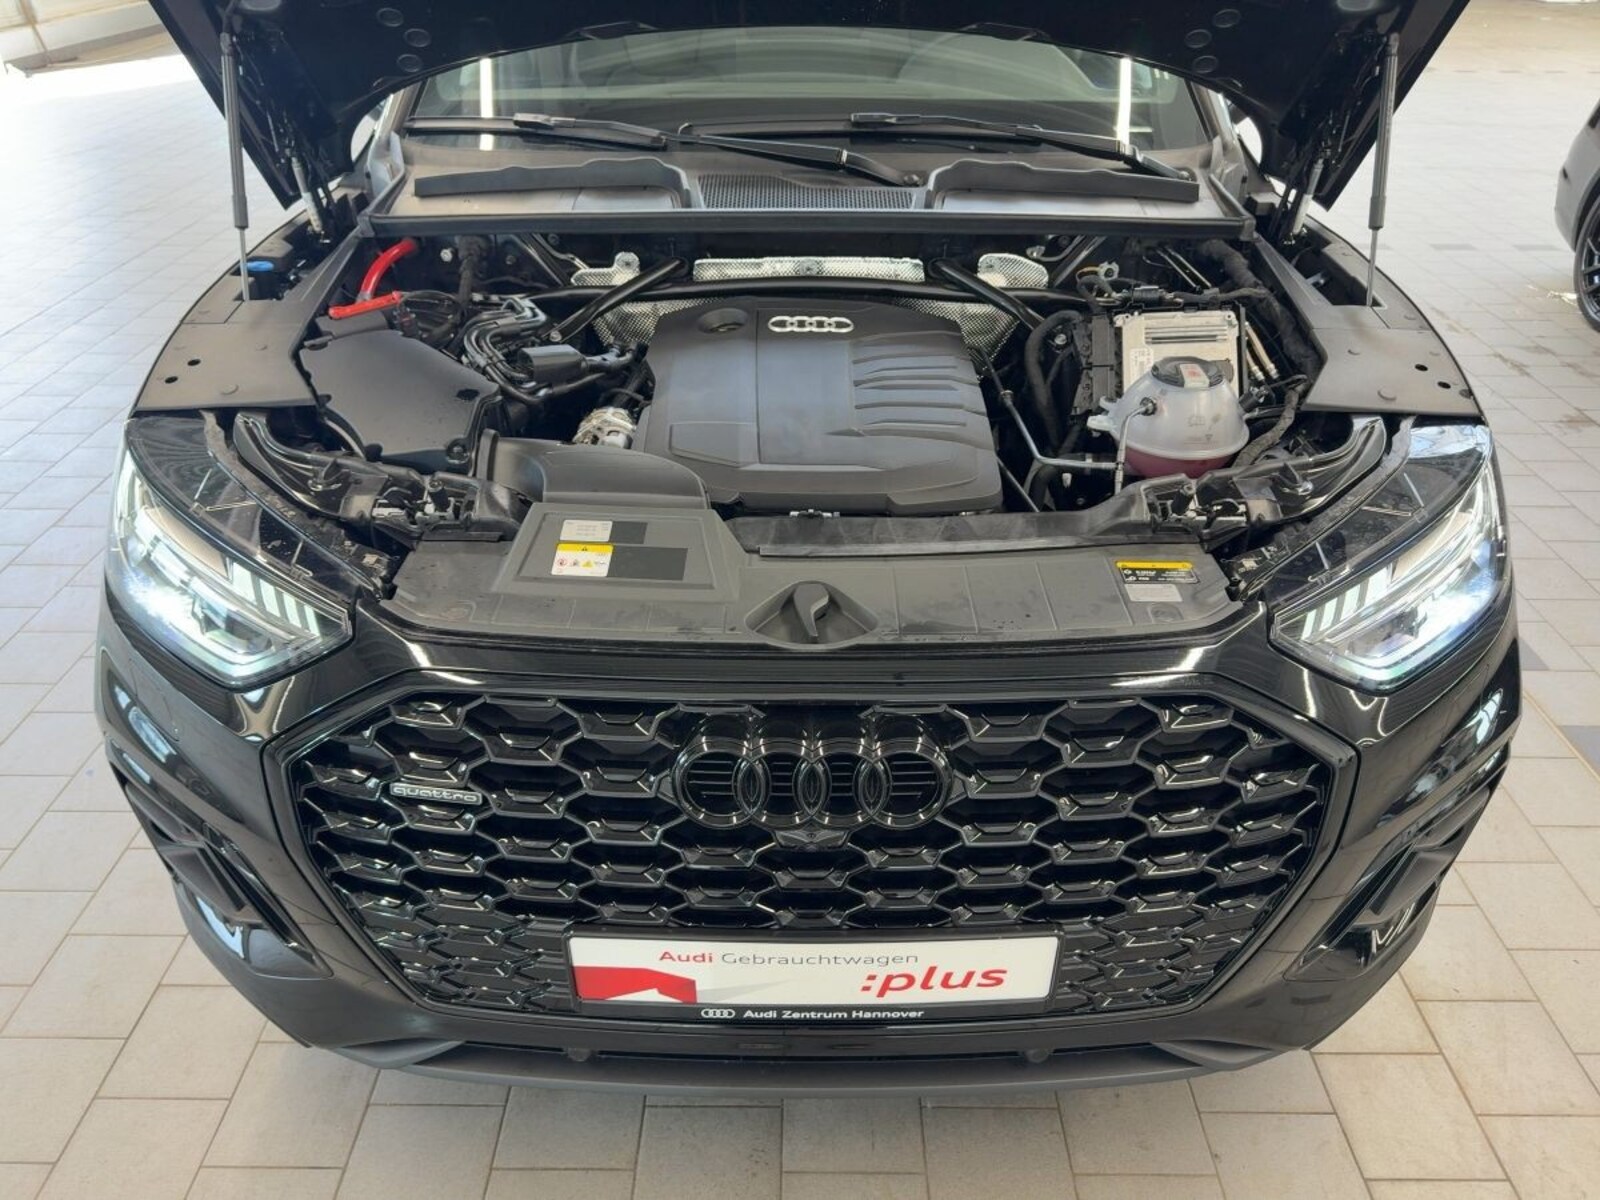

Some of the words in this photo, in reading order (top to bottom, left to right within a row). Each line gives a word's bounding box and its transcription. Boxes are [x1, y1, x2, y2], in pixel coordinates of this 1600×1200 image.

[393, 786, 477, 802] quattro
[659, 951, 713, 963] Audi
[721, 953, 919, 967] Gebrauchtwagen
[743, 1010, 777, 1019] Audi
[781, 1010, 848, 1019] Zentrum
[852, 1010, 924, 1019] Hannover
